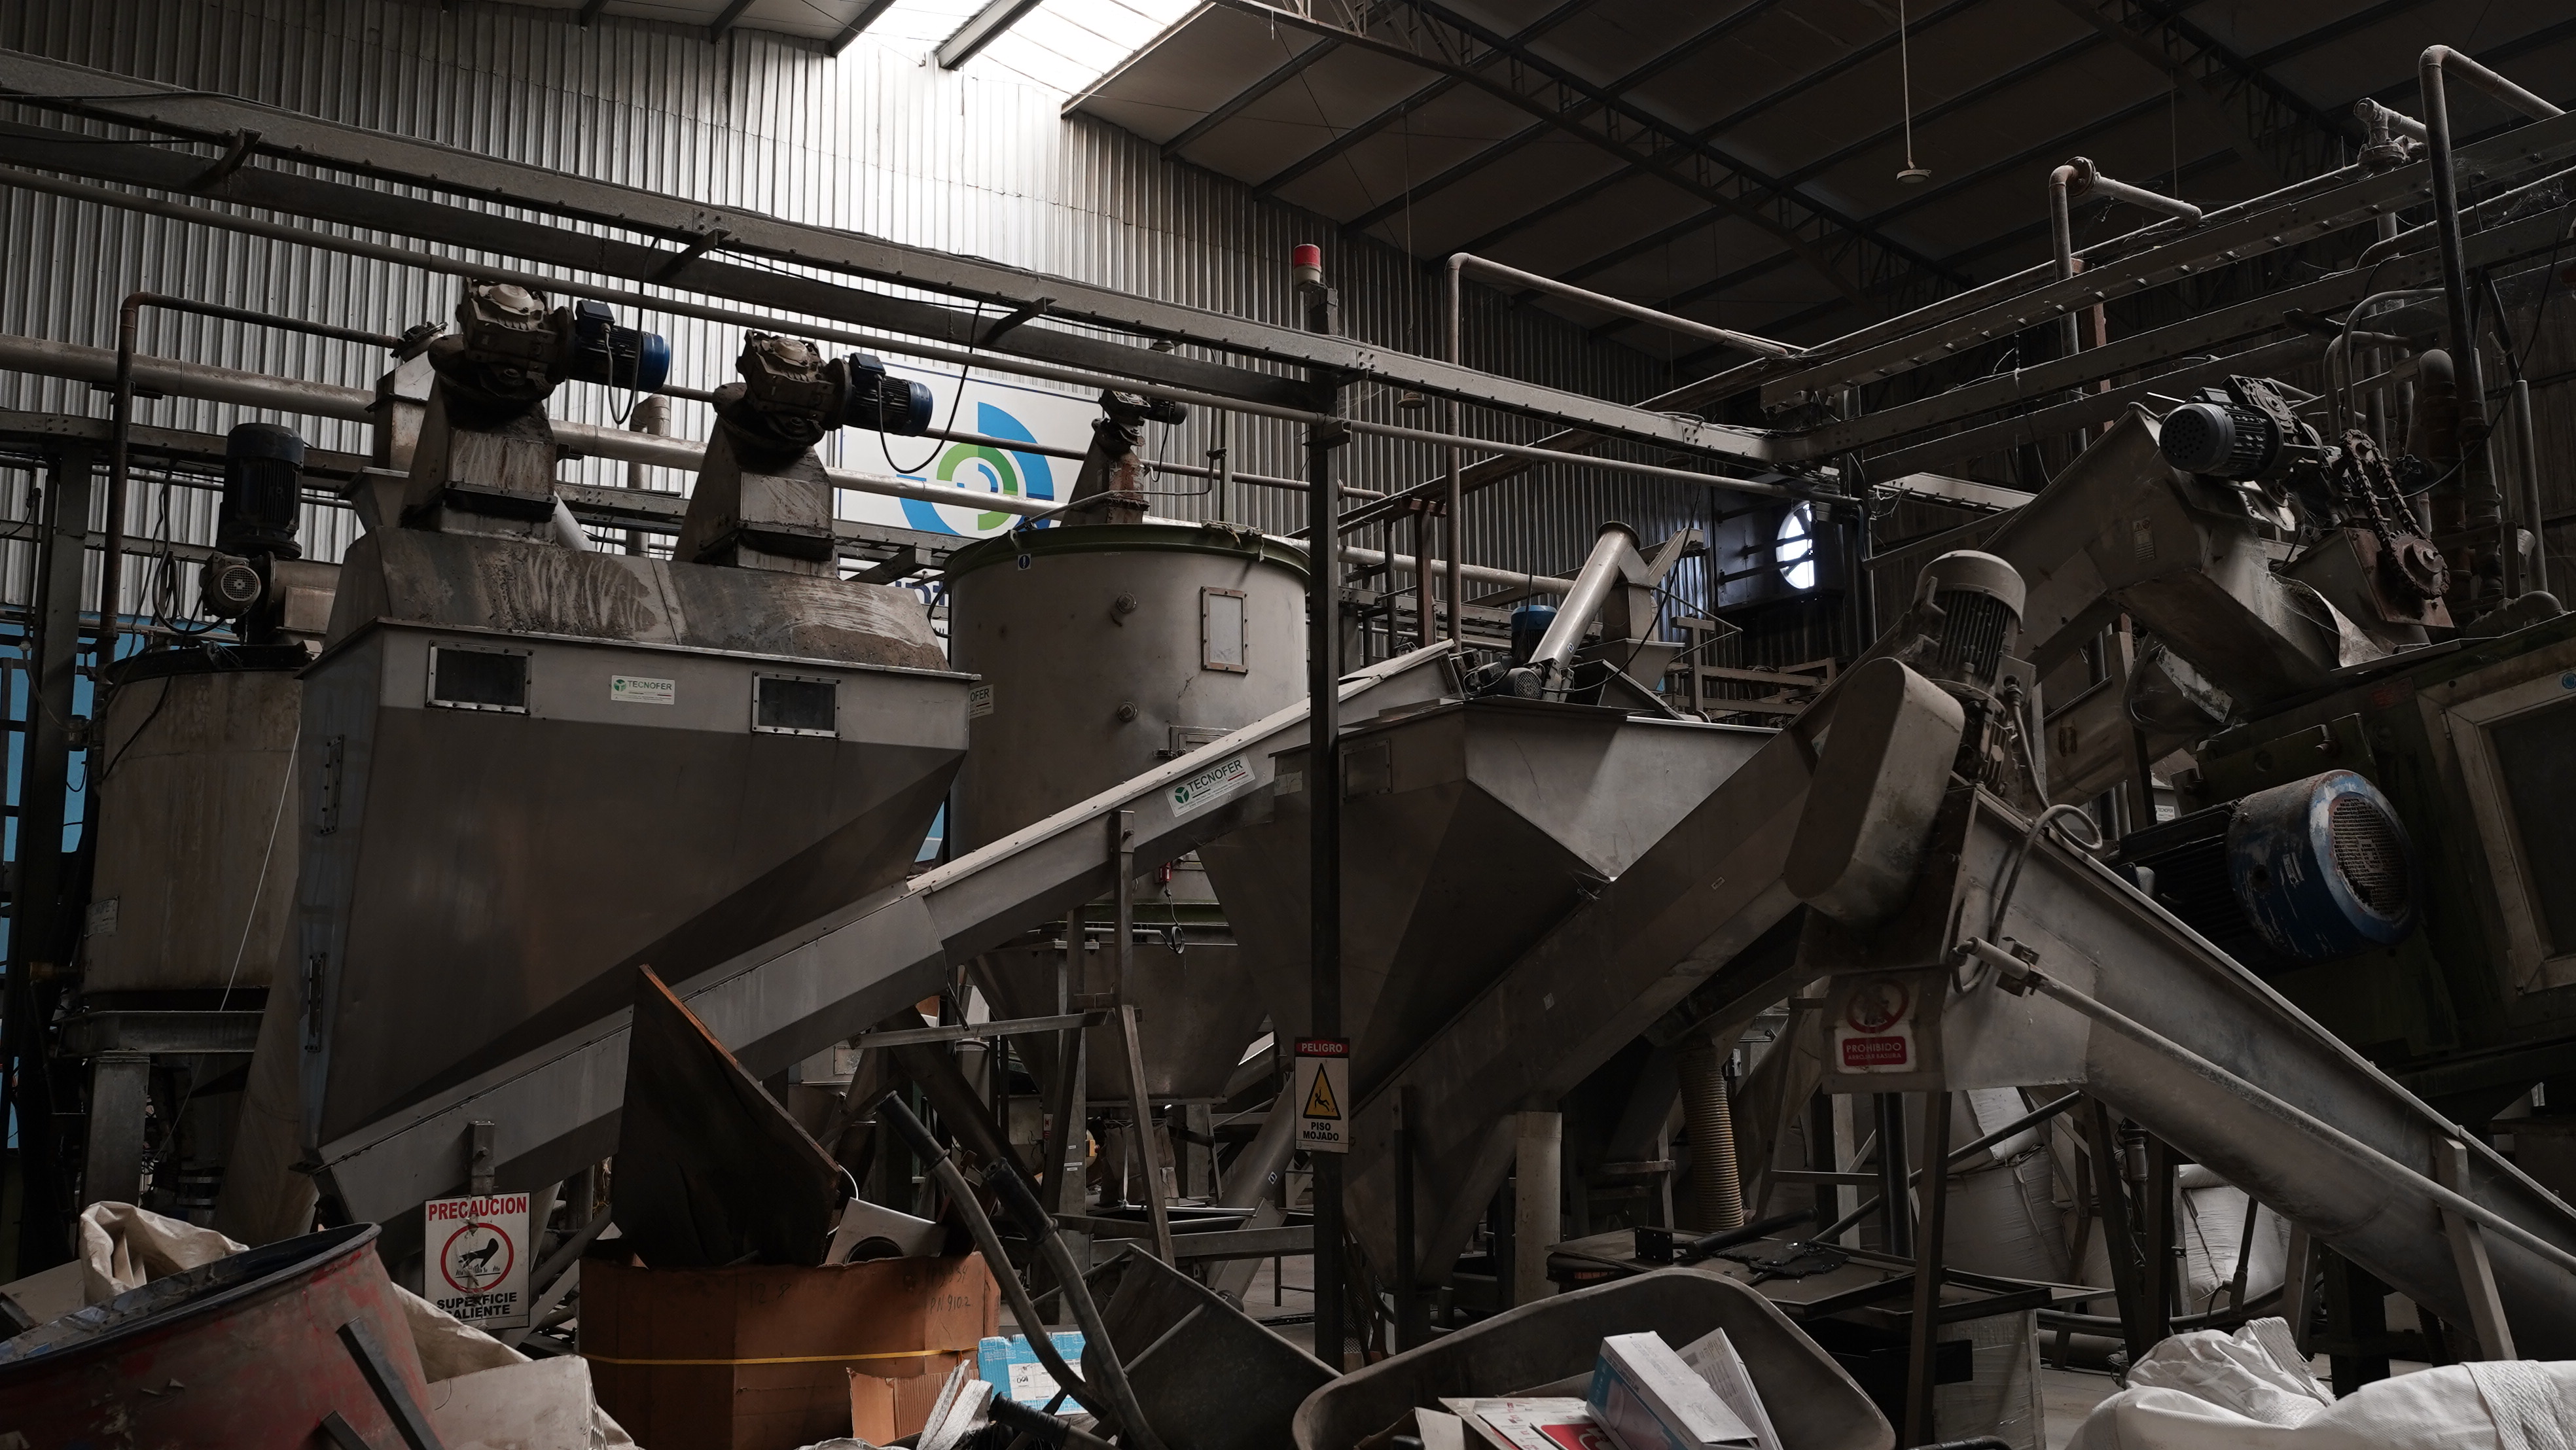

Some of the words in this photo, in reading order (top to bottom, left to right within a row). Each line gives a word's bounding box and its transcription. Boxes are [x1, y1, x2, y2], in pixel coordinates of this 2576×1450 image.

[628, 681, 672, 690] TECNOFER
[970, 688, 990, 702] OFER
[1187, 760, 1243, 792] TECNOFER
[1302, 1043, 1342, 1052] PELIGRO
[1846, 1043, 1901, 1052] PROHIBIDO
[1311, 1122, 1331, 1131] PISO
[1303, 1131, 1340, 1141] MOJADO
[429, 1197, 527, 1221] PRECAUCION
